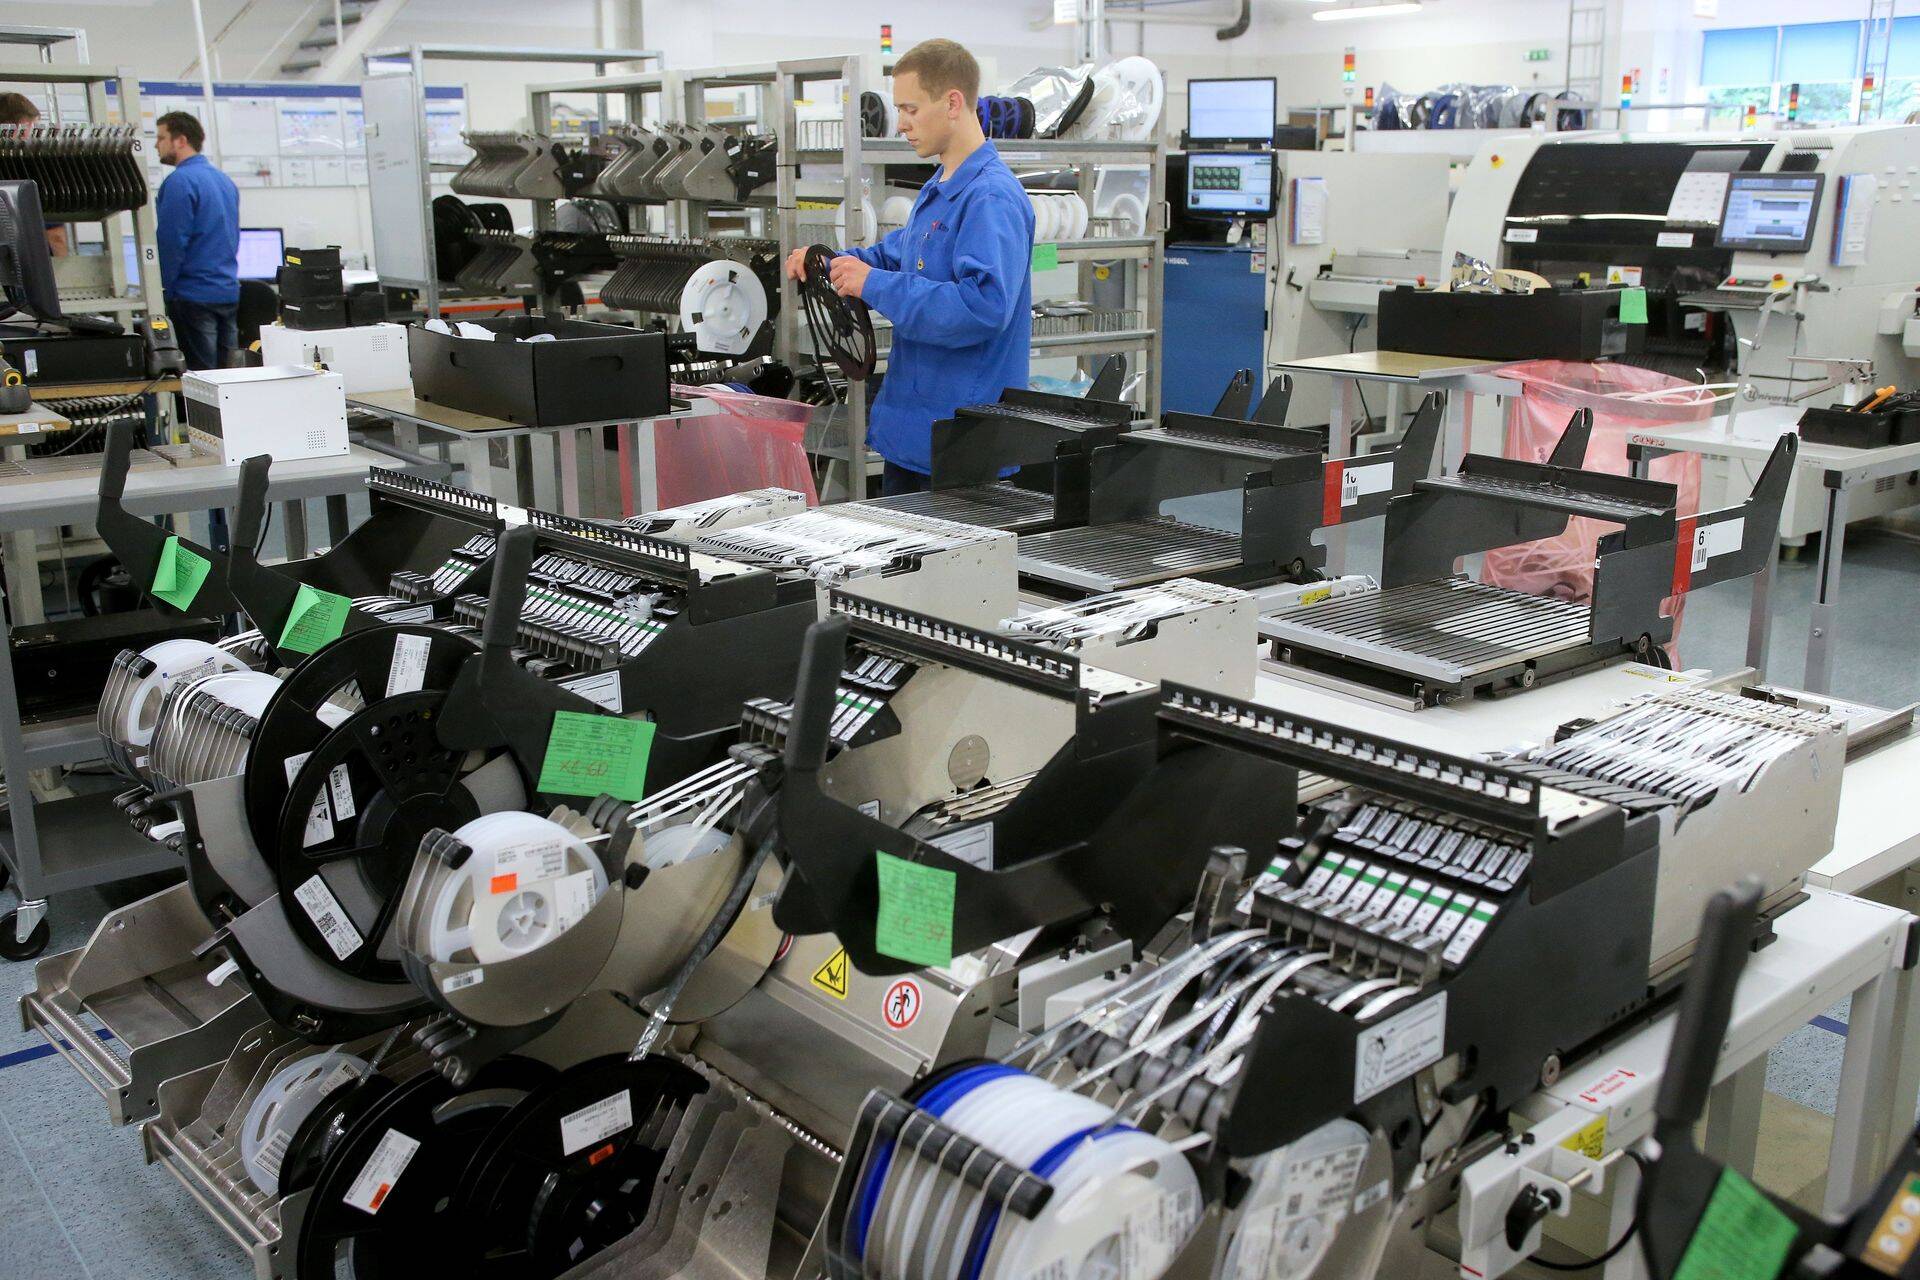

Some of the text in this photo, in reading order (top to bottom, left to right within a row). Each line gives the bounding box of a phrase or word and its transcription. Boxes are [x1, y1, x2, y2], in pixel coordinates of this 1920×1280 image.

[134, 140, 142, 151] 8
[146, 248, 154, 260] 8
[1698, 530, 1705, 546] 6
